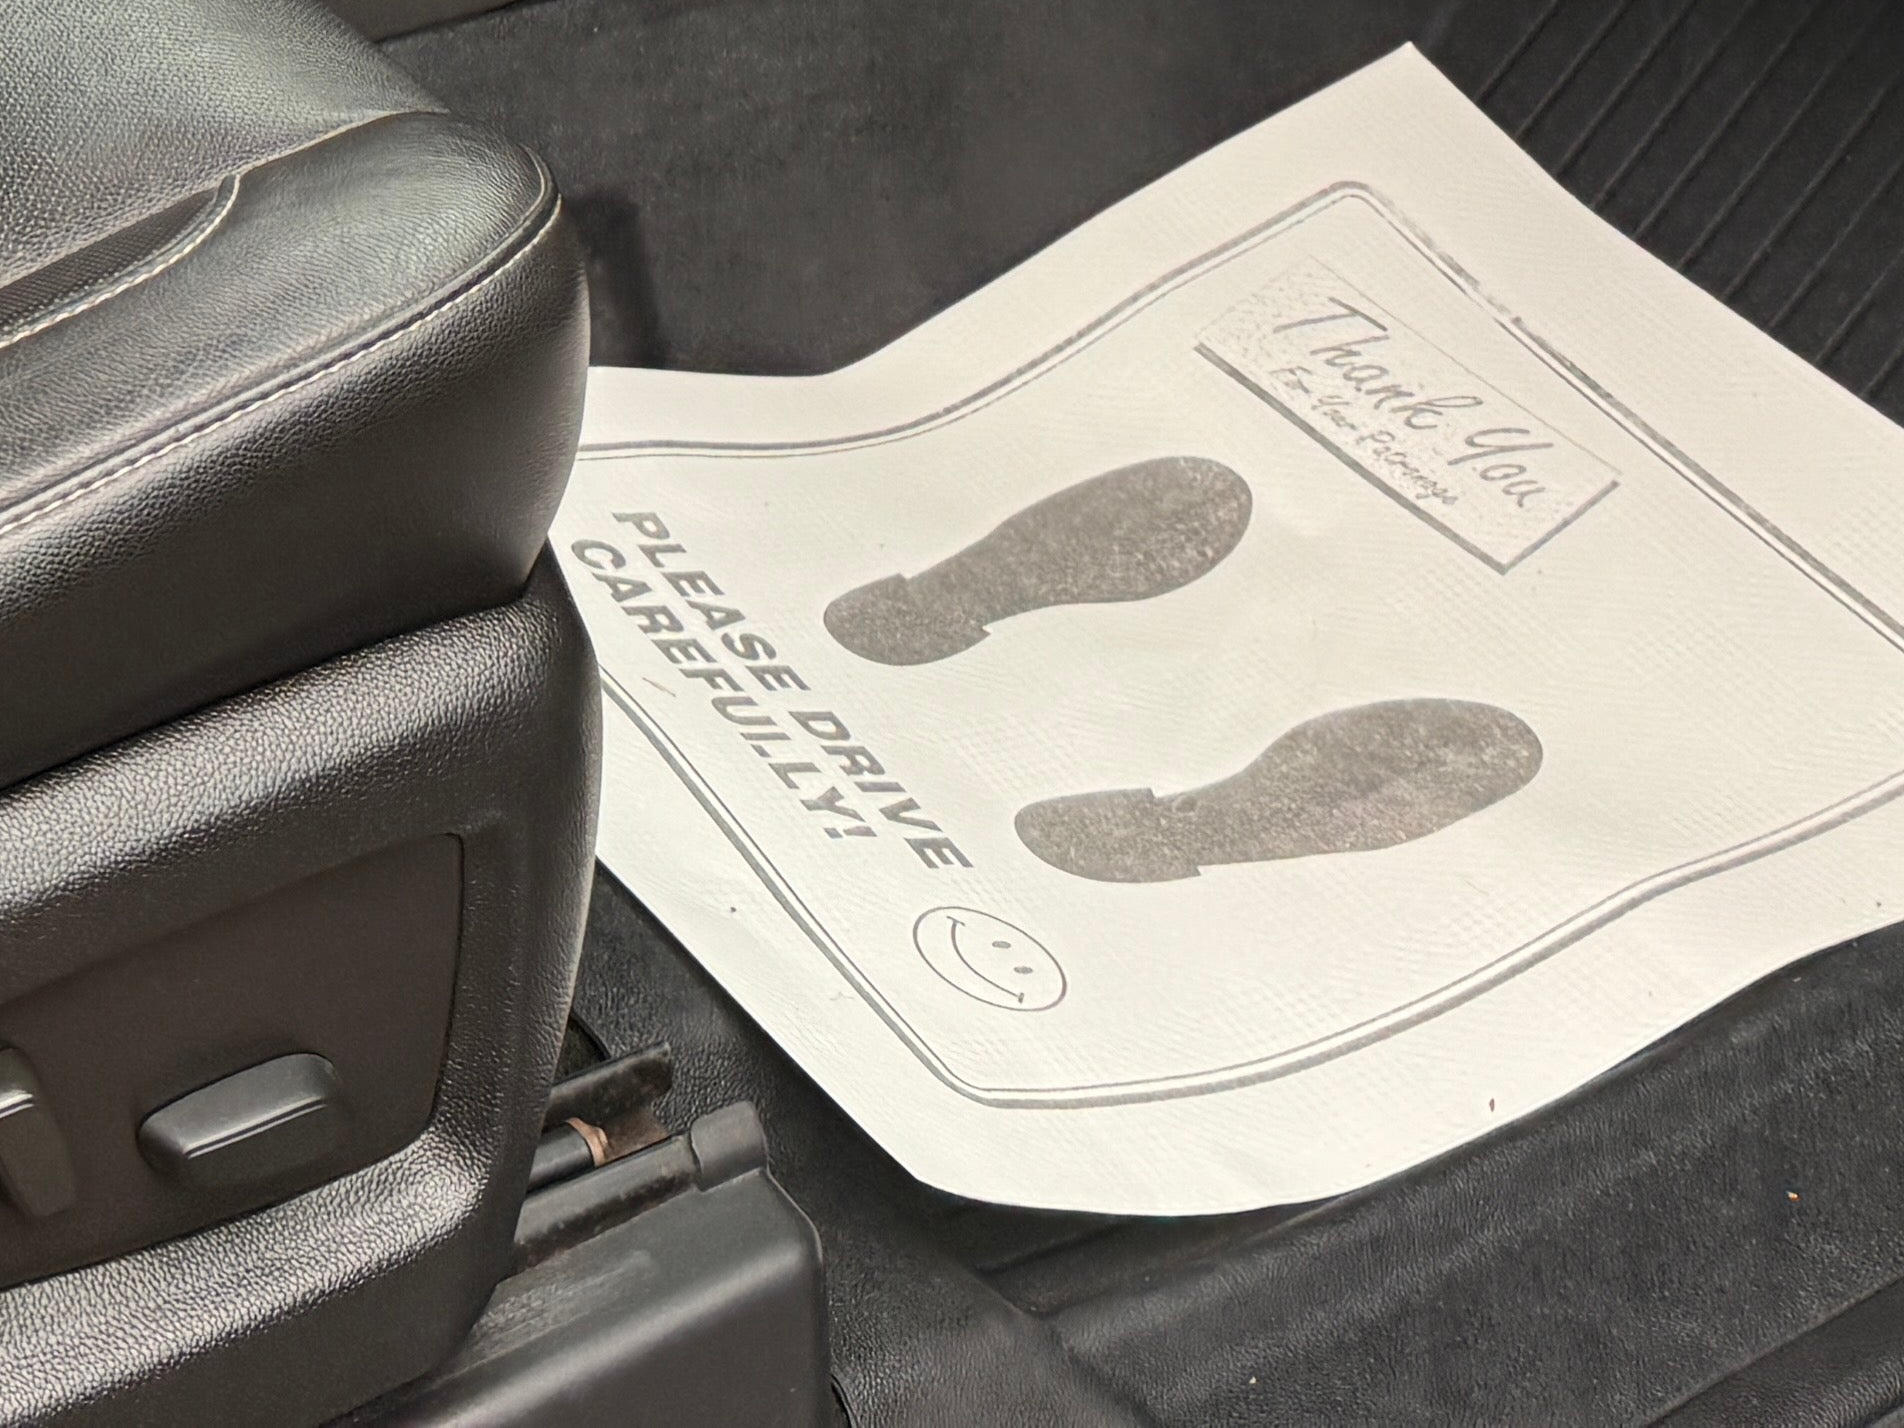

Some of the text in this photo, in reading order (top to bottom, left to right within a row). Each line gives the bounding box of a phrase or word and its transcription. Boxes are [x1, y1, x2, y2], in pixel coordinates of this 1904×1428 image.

[1273, 297, 1554, 508] Thank You
[1310, 394, 1358, 431] Your
[570, 538, 878, 840] CAREFULLY!
[610, 511, 974, 870] PLEASE DRIVE
